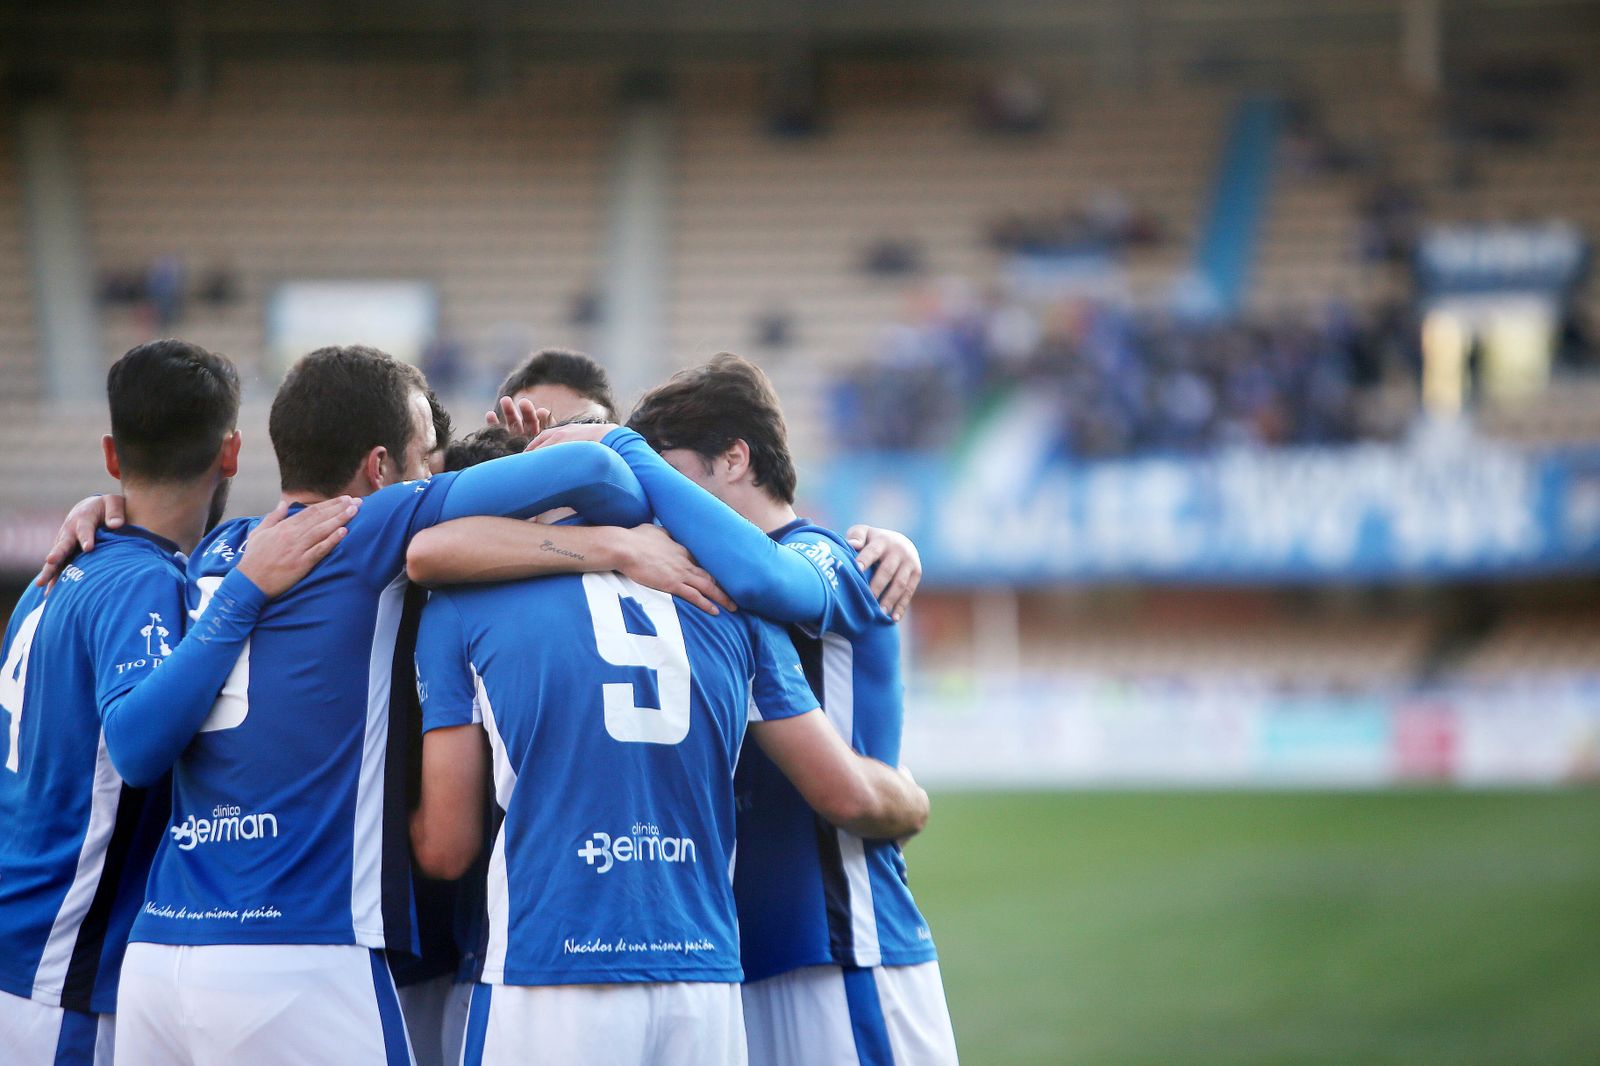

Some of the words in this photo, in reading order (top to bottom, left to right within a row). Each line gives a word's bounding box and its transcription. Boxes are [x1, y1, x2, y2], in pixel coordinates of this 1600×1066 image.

[197, 598, 236, 645] KIPTA
[581, 571, 691, 745] 9
[0, 600, 48, 774] 4
[144, 901, 175, 918] Nacidos
[175, 905, 187, 919] de
[187, 910, 203, 920] una
[205, 907, 238, 919] misma
[240, 905, 282, 924] pasión
[564, 938, 612, 954] Nacidos
[615, 938, 627, 953] de
[629, 941, 648, 952] una
[650, 940, 682, 952] misma
[684, 939, 715, 955] pasión
